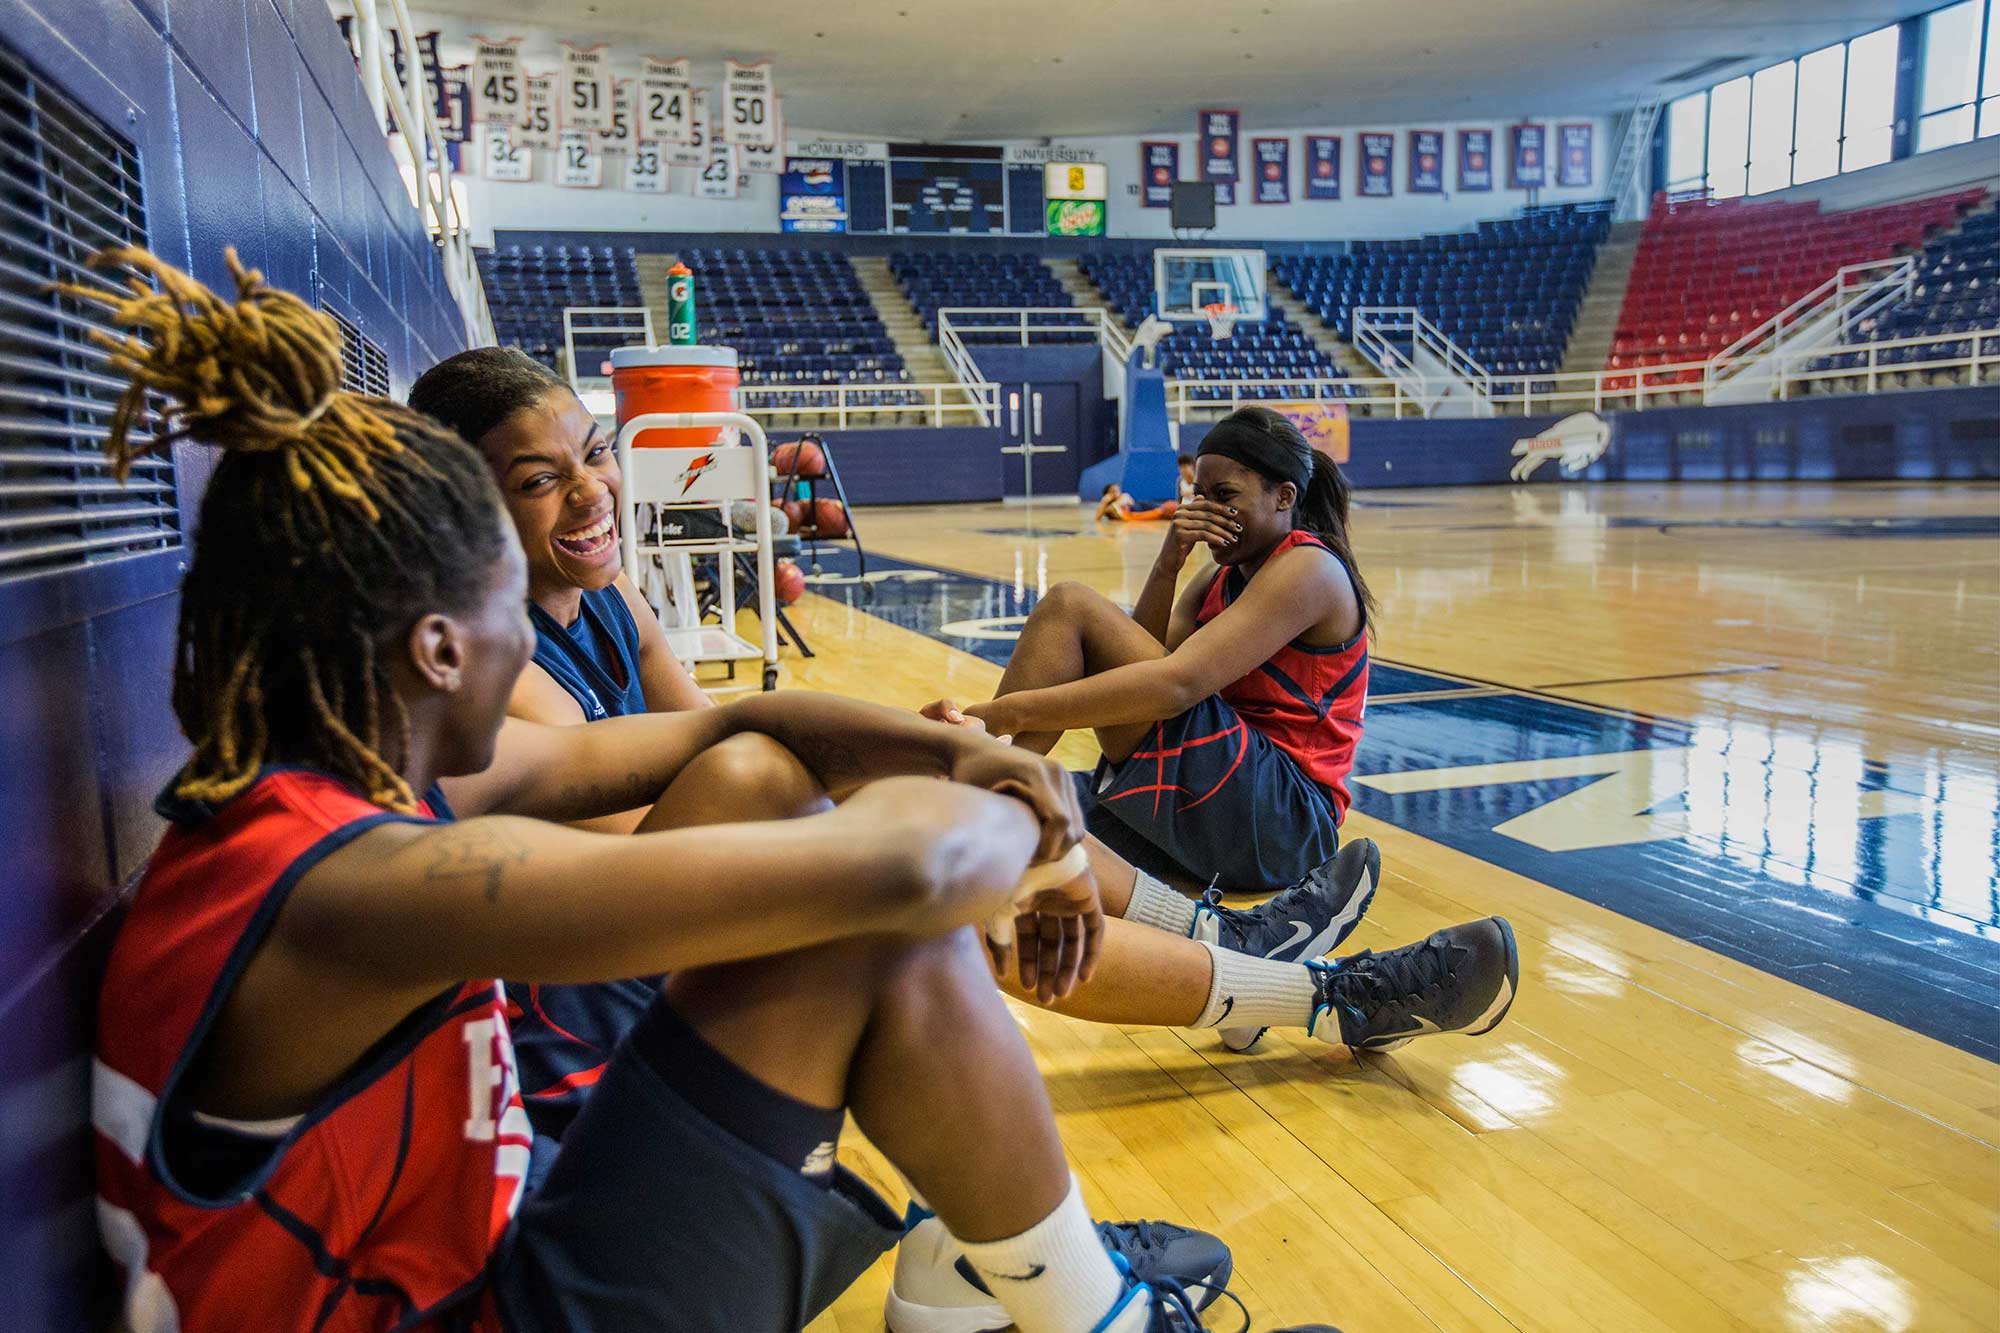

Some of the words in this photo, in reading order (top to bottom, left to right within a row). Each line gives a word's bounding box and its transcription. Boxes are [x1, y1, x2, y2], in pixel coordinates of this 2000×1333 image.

[484, 76, 518, 103] 45
[573, 81, 598, 109] 51
[650, 93, 680, 122] 24
[734, 97, 764, 124] 50
[566, 145, 588, 169] 12
[1012, 147, 1098, 161] UNIVERSITY
[671, 281, 690, 303] G
[671, 321, 692, 340] 02
